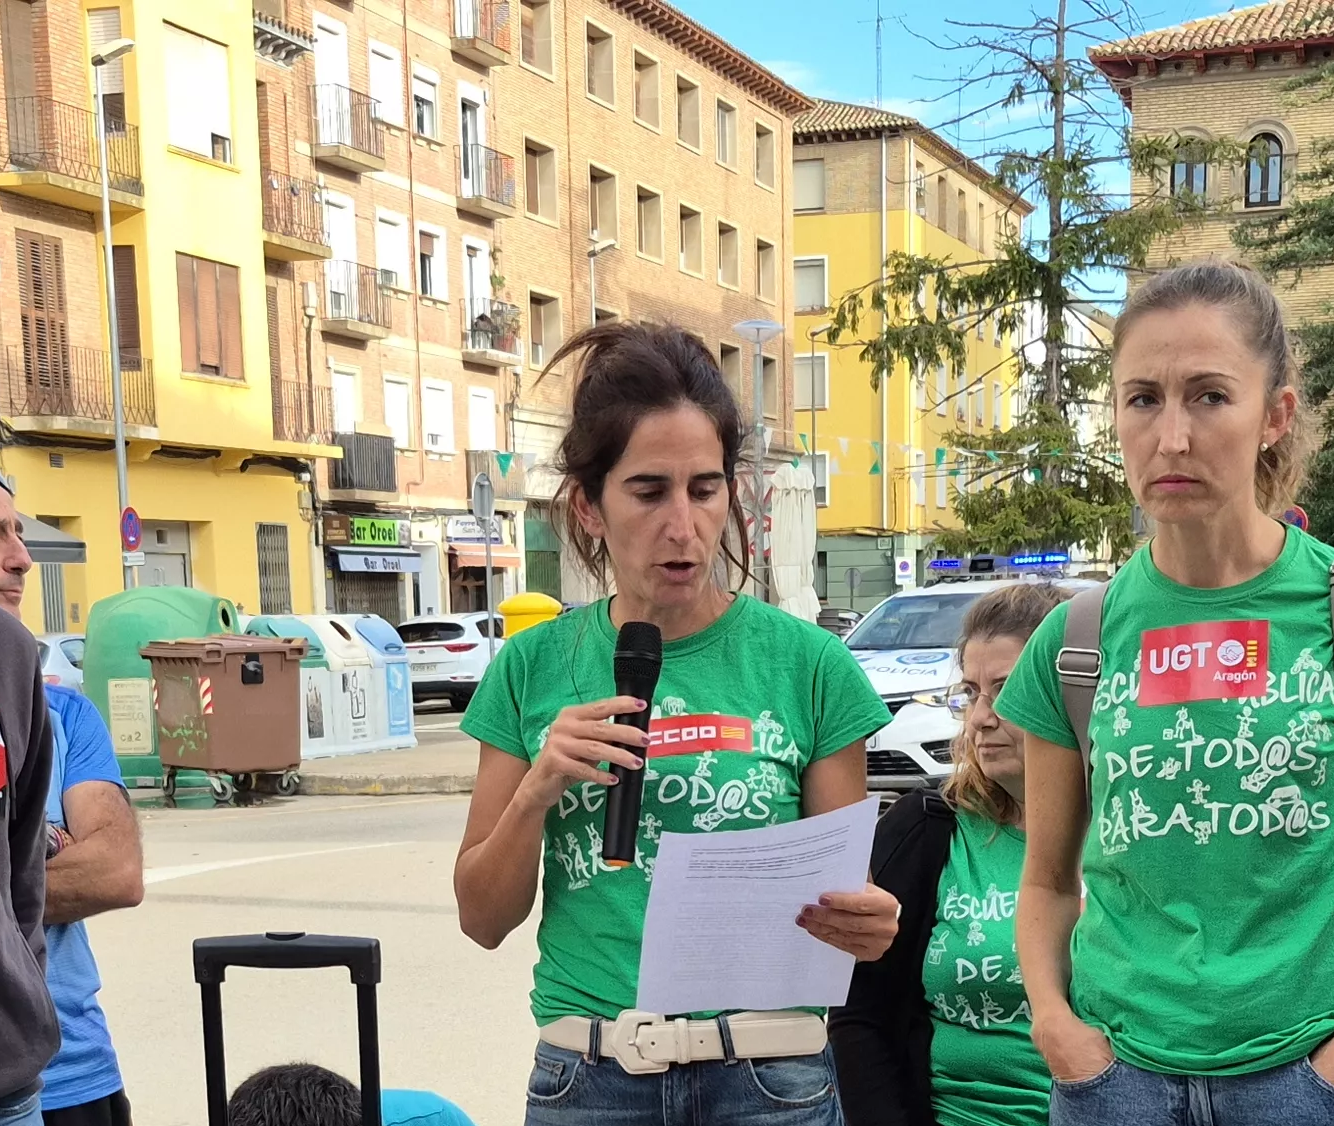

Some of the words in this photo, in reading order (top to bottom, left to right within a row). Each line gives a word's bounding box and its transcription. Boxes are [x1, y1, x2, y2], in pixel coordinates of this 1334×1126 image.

[350, 520, 366, 540] Bar
[370, 521, 396, 542] Oroel
[364, 557, 377, 569] Bar
[382, 558, 402, 570] Oroel
[1149, 641, 1213, 675] UGT
[1213, 670, 1257, 683] Aragón
[1105, 744, 1154, 783] DE
[1175, 735, 1317, 778] TOD@S
[647, 774, 772, 820] OD@S
[1098, 803, 1194, 847] PARA
[1204, 801, 1331, 838] TOD@S
[943, 891, 1019, 921] ESCUE
[955, 955, 1003, 984] DE
